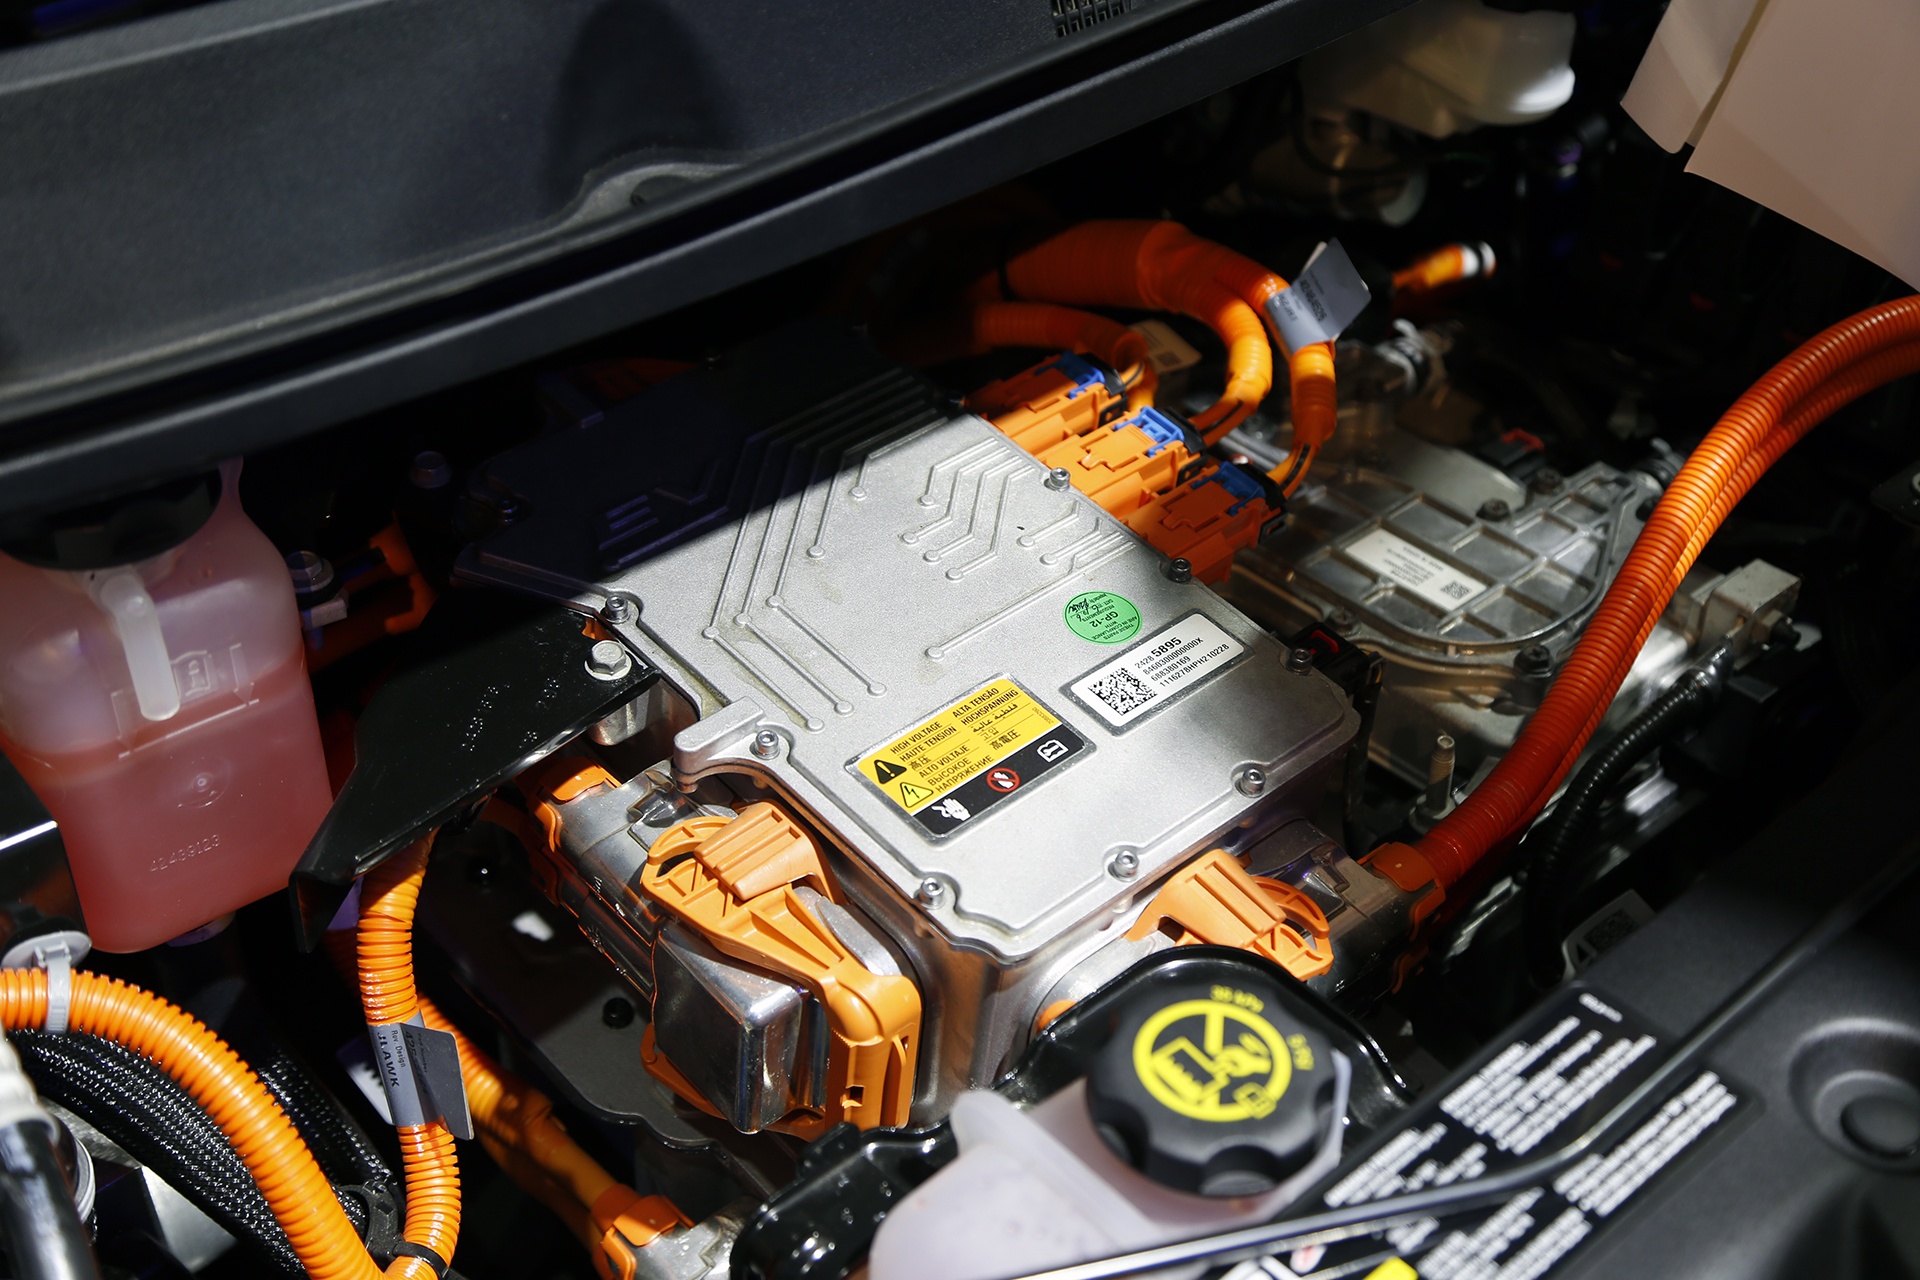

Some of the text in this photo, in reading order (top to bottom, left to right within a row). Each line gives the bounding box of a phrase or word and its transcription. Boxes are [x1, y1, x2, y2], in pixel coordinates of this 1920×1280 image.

[1089, 610, 1119, 628] GP-12
[1092, 623, 1122, 640] COMPLIANCE
[1104, 620, 1118, 629] WITH
[1134, 636, 1182, 669] 2428 5895
[1159, 643, 1230, 687] 1116278HPH210228
[1150, 655, 1191, 682] 688380169
[953, 687, 1000, 718] ALTA TENSÃO
[961, 689, 1019, 725] HOCHSPANNUNG
[891, 721, 942, 754] HIGH VOLTAGE
[970, 719, 993, 733] عالية
[980, 726, 999, 740] 고압
[899, 725, 957, 762] HAUTE TENSION
[919, 744, 970, 778] ALTO VOLTAJE
[927, 757, 972, 786] ВЫСОКОЕ
[935, 755, 994, 793] НАПРЯЖЕНИЕ
[150, 834, 220, 872] 42439123
[395, 1045, 406, 1068] Design
